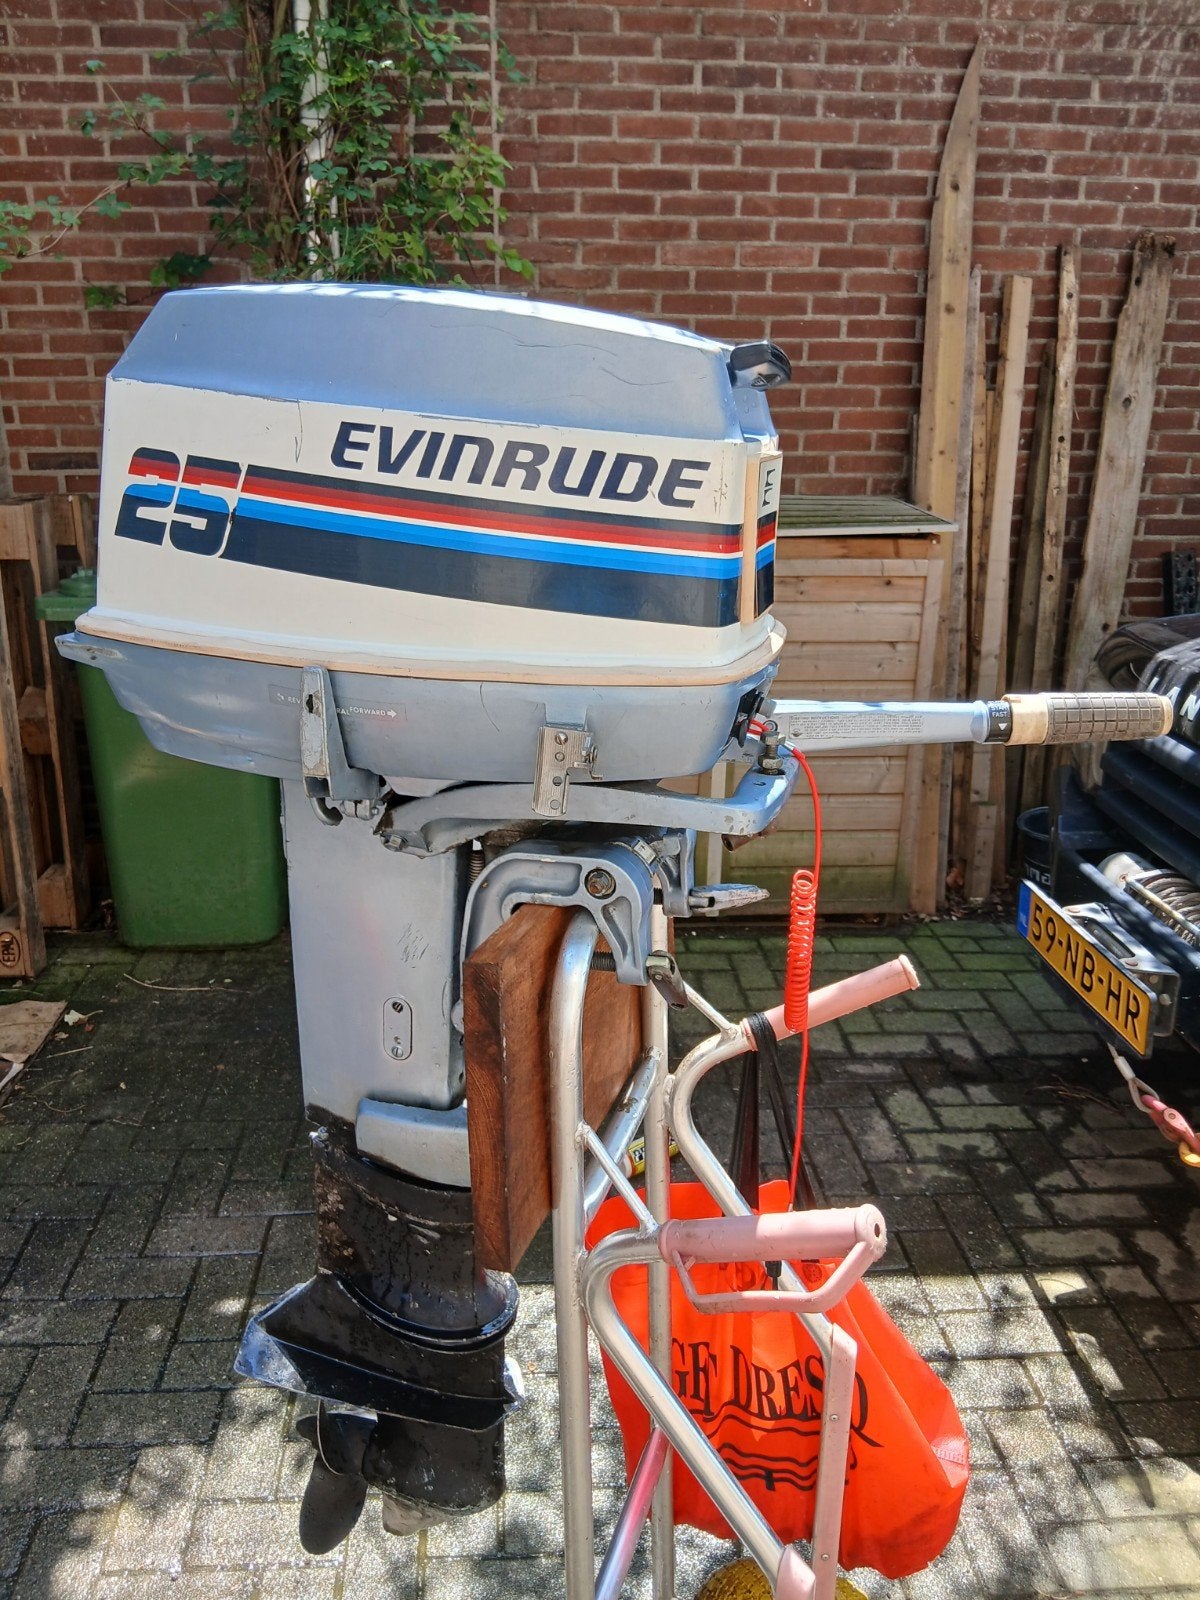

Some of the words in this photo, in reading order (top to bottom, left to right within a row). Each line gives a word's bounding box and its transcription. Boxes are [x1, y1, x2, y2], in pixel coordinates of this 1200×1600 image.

[114, 446, 243, 557] 25
[330, 420, 711, 510] EVINRUDE
[349, 706, 386, 717] FORWARD
[1031, 901, 1141, 1041] 59-NB-HR
